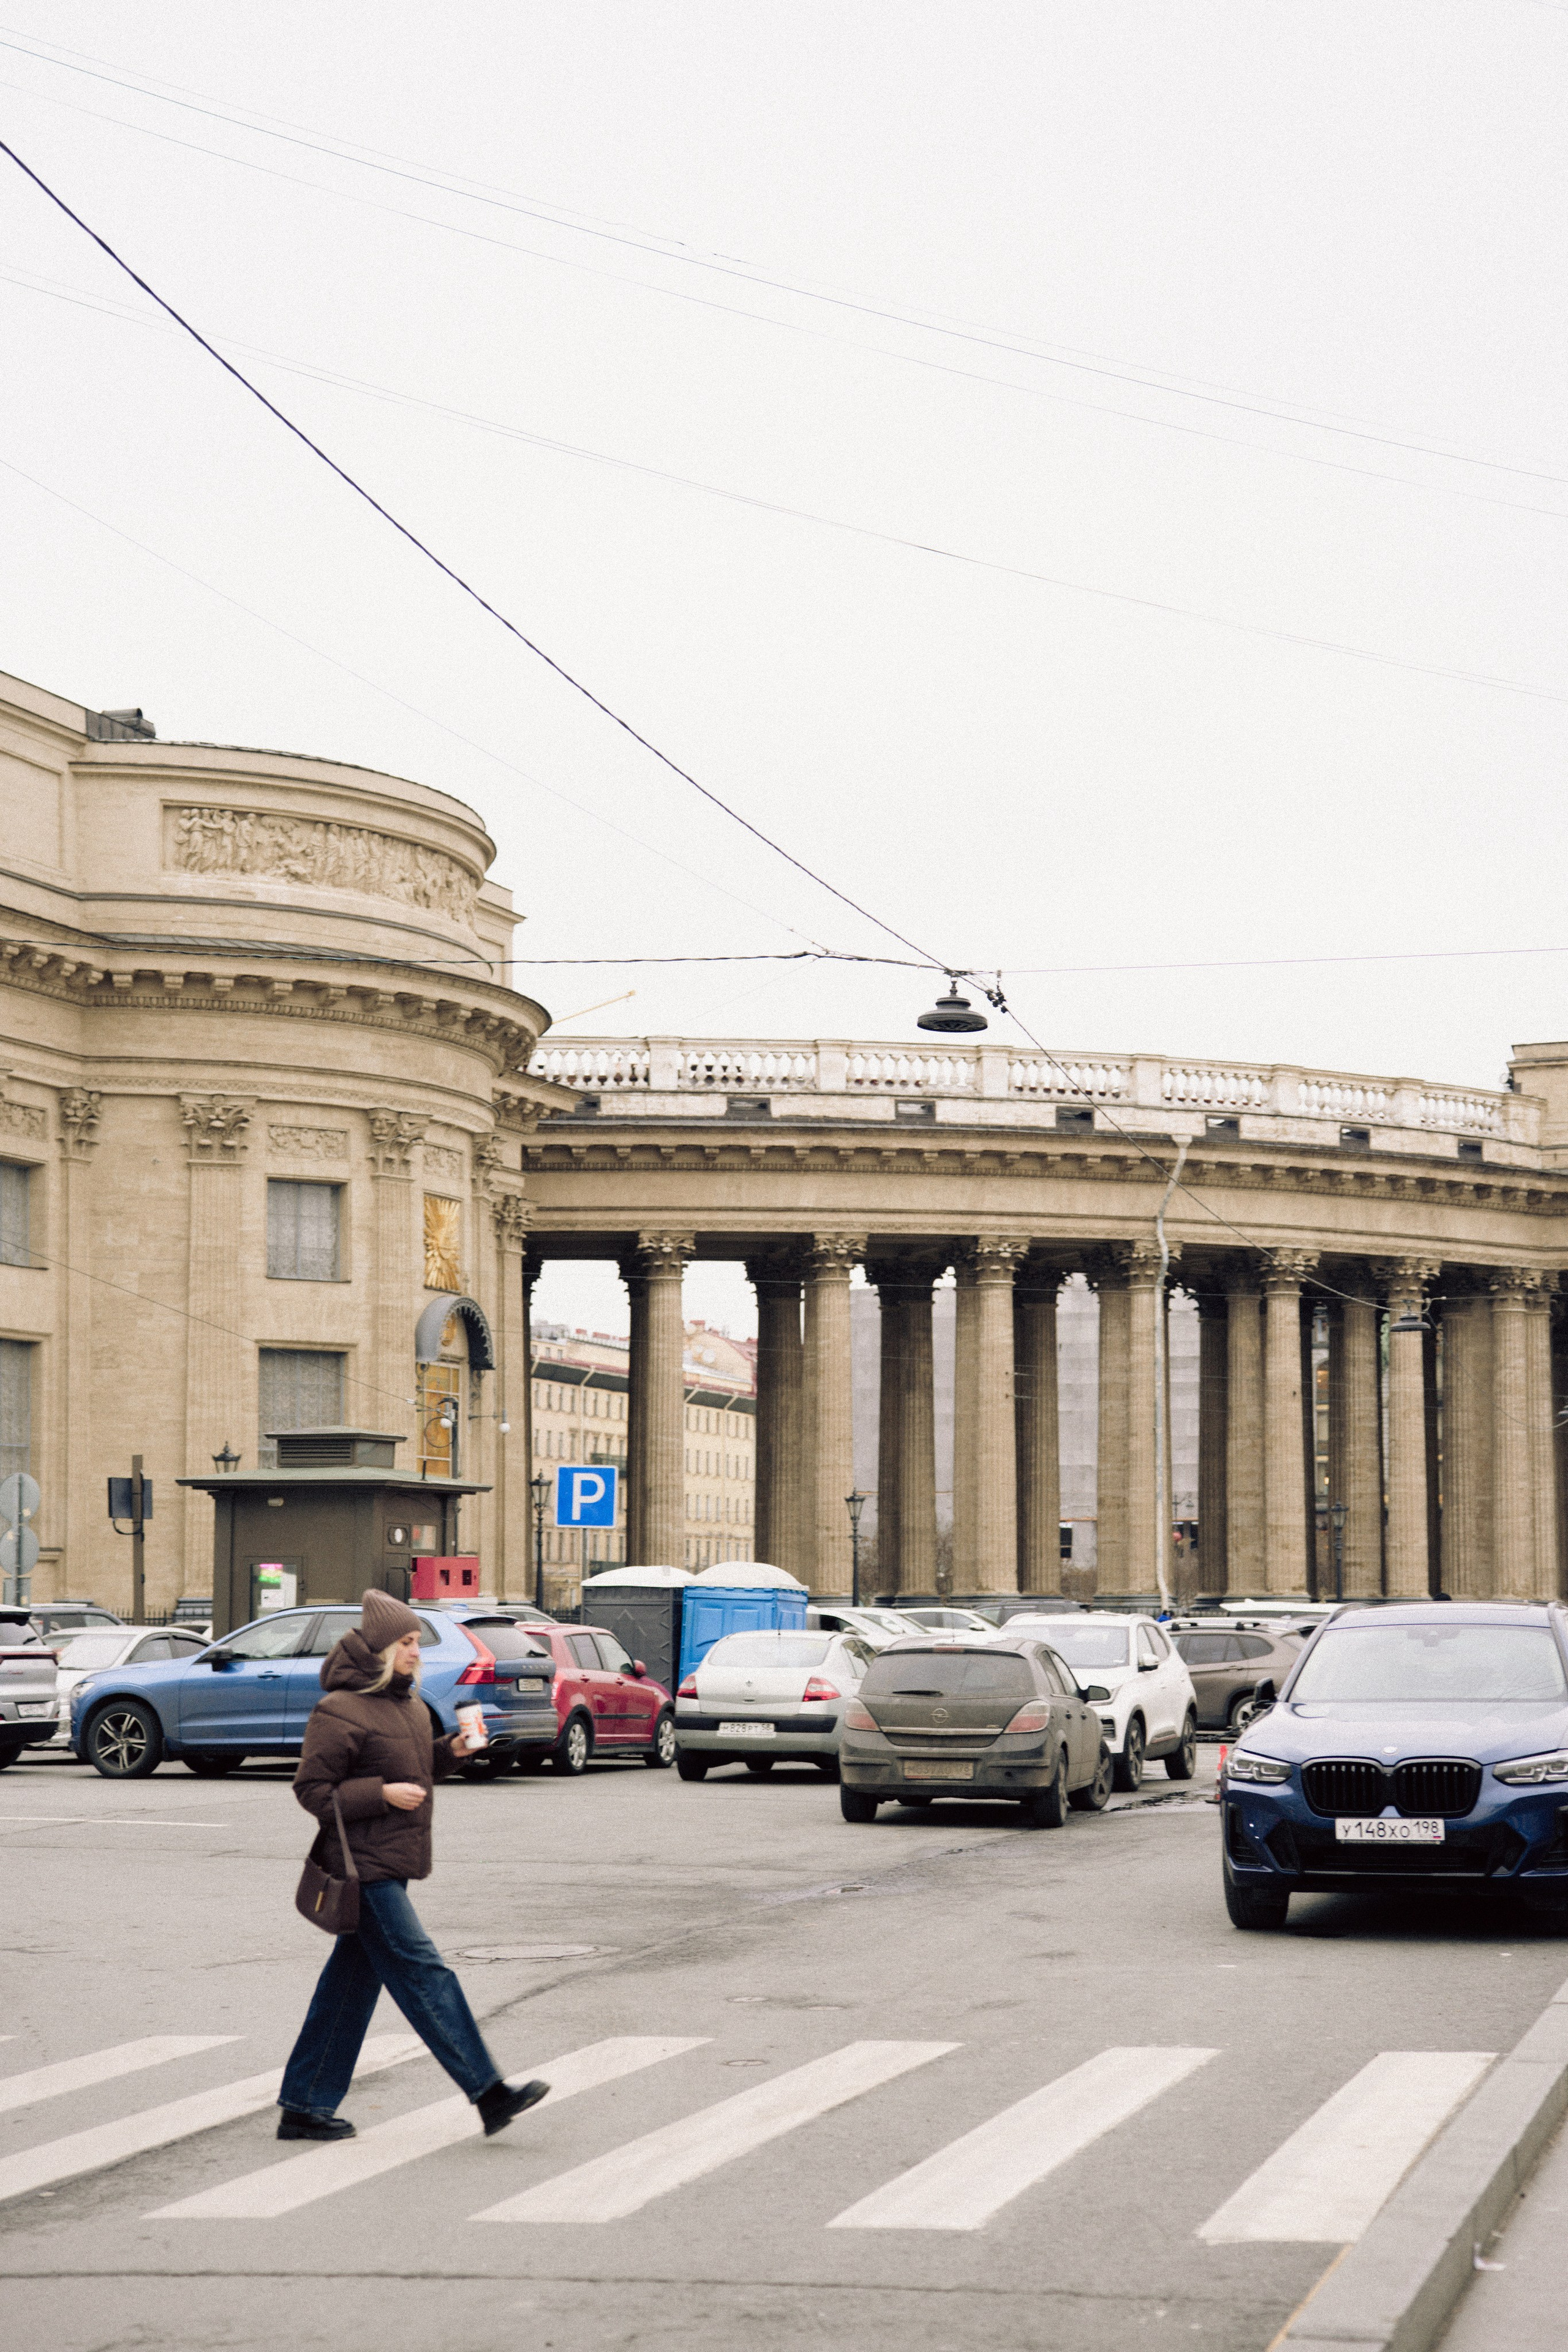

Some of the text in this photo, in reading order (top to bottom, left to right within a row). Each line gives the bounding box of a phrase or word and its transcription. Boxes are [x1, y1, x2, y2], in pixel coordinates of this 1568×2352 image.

[571, 1472, 606, 1520] P
[1343, 1821, 1439, 1838] У148ХО 198
